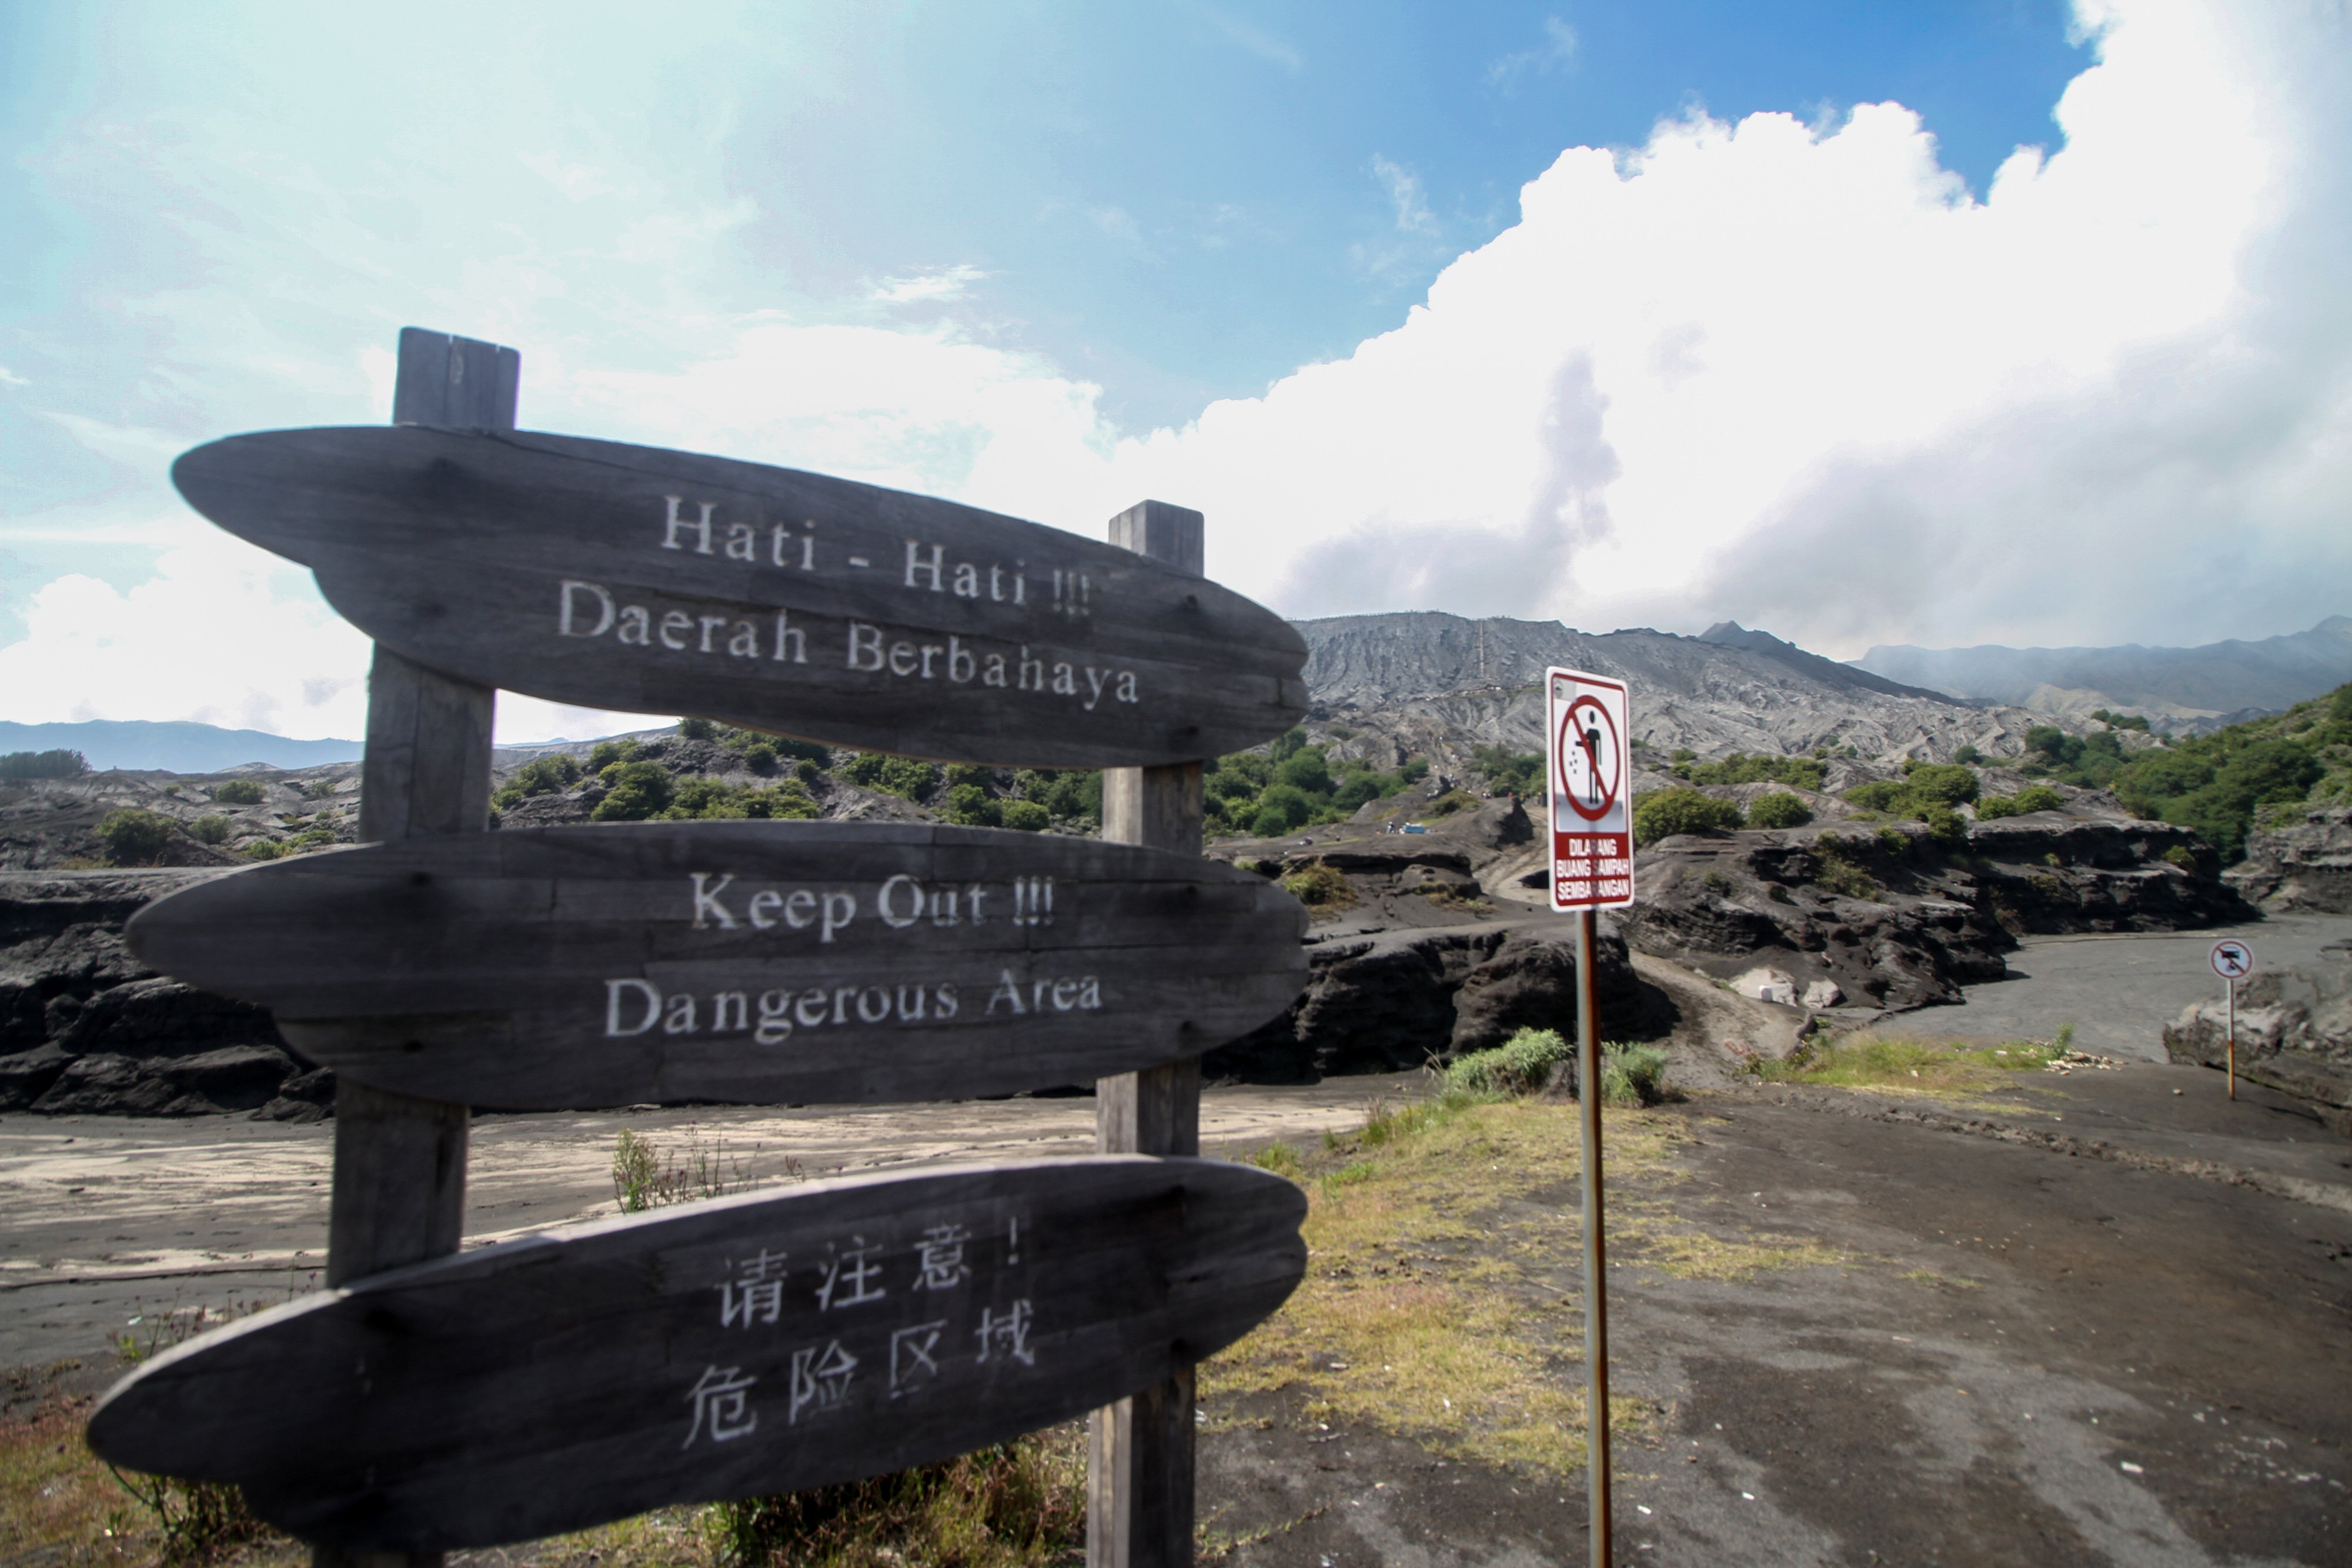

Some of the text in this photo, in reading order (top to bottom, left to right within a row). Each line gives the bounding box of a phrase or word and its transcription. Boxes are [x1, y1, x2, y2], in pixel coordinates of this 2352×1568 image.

[660, 495, 816, 571] Hati
[903, 540, 1025, 606] Hati
[1051, 567, 1091, 617] !!!
[558, 579, 1140, 710] Daerah Berbahaya
[1556, 859, 1591, 878] BUANG
[1569, 838, 1617, 857] DILARANG
[689, 872, 1056, 942] Keep Out !!!
[604, 967, 1103, 1045] Dangerous Area
[682, 1298, 1035, 1451] 危险区域
